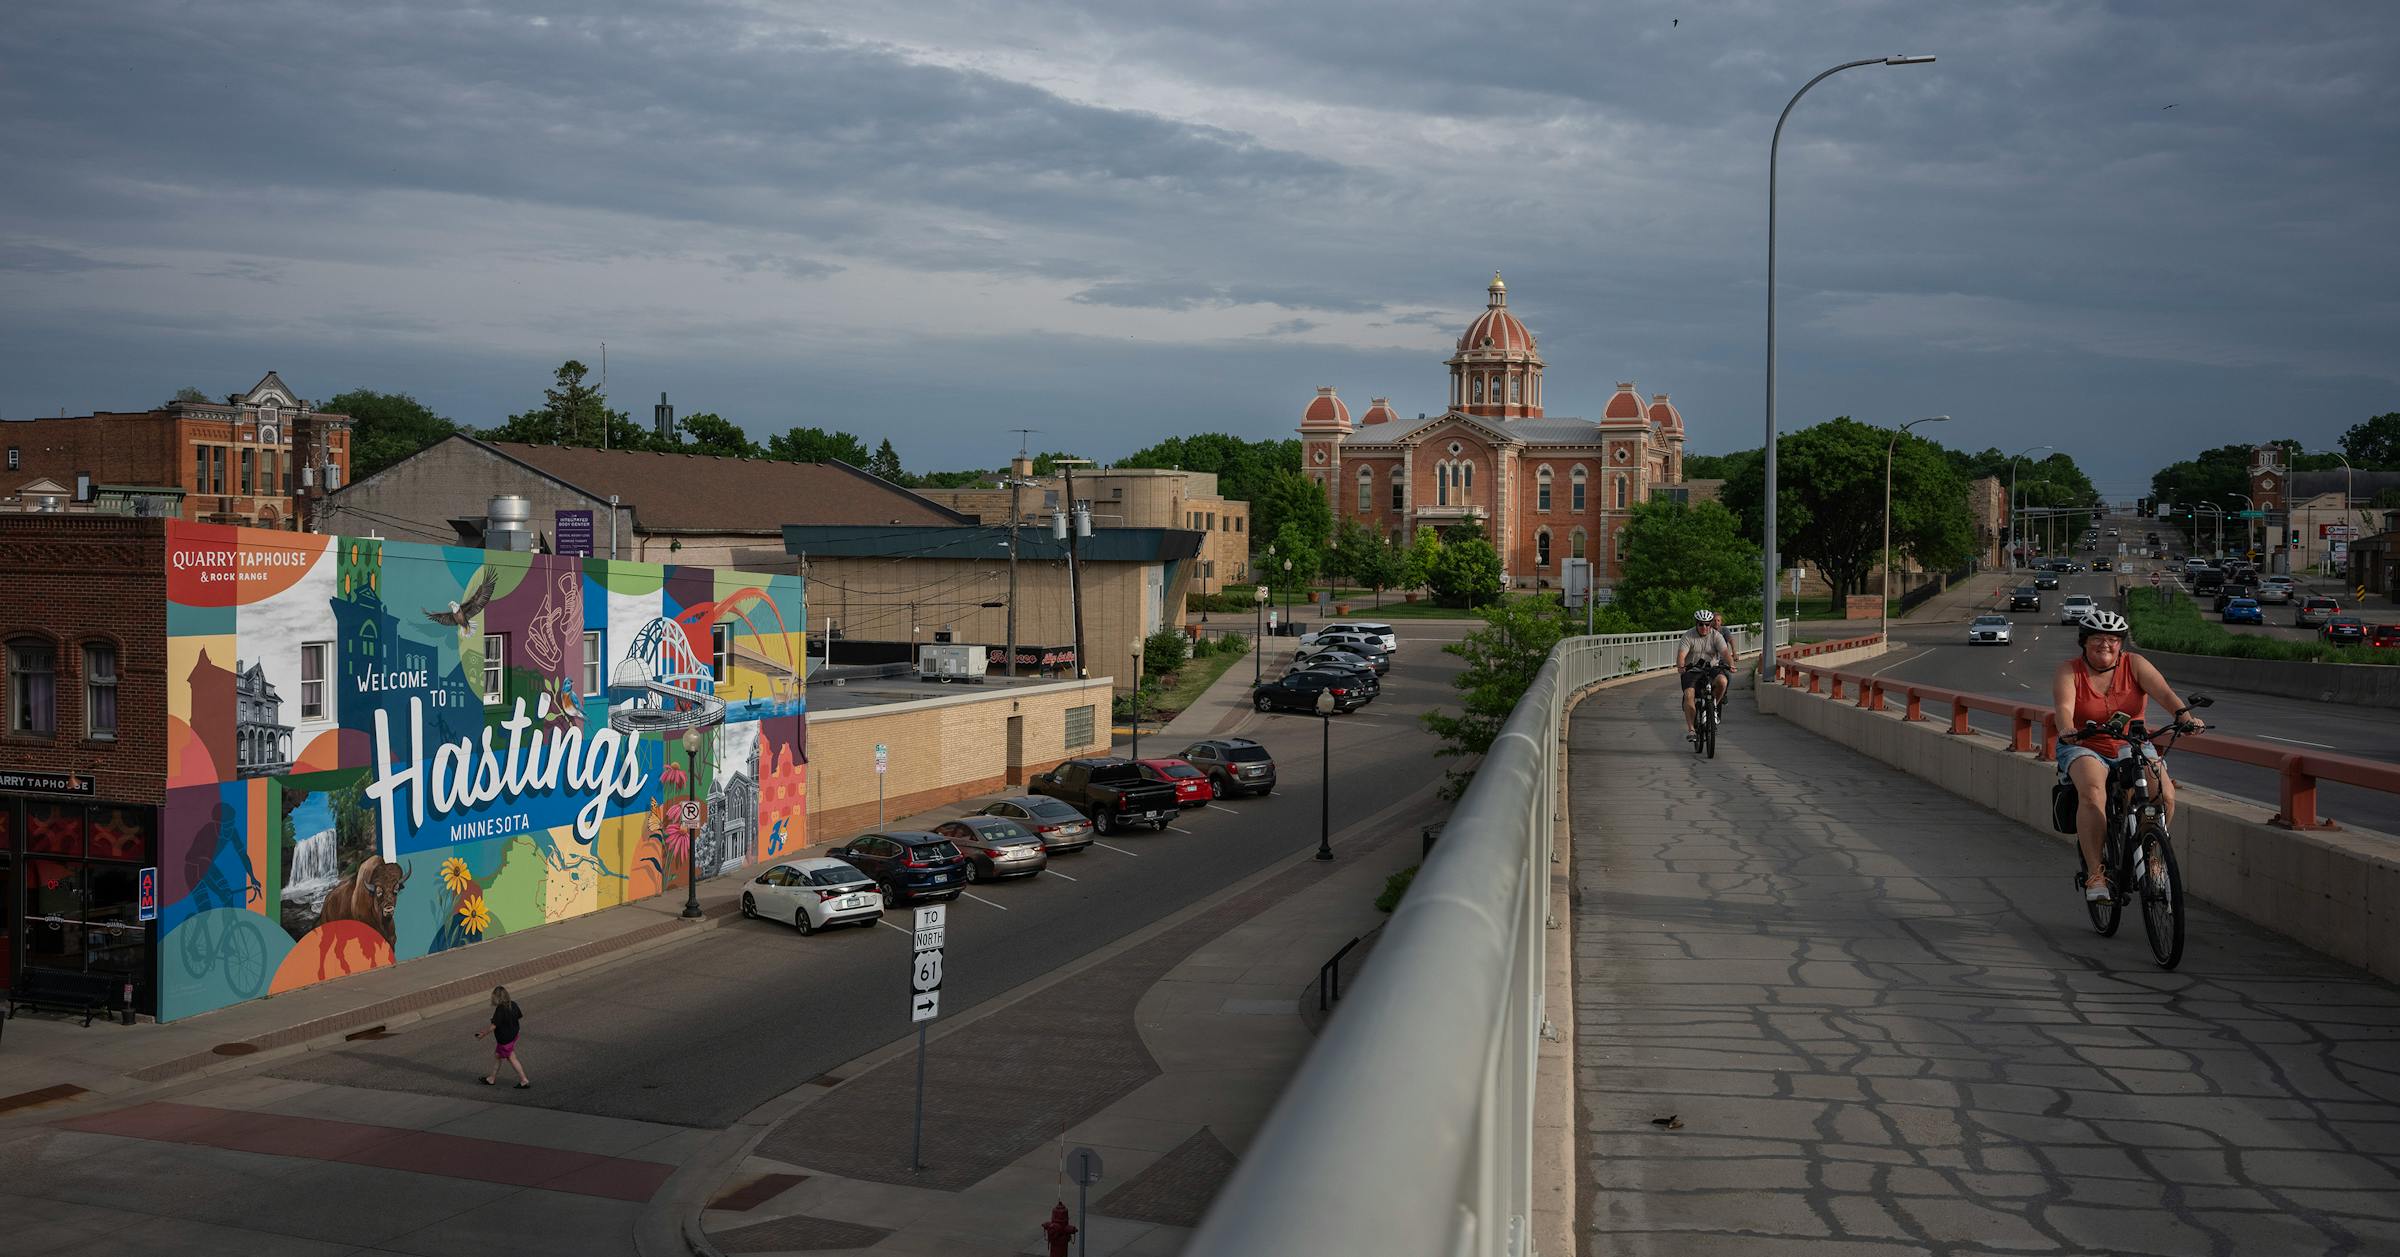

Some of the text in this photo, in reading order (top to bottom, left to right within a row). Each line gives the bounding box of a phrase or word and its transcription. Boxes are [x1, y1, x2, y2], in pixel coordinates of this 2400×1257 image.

[173, 551, 306, 570] QUARRY TAPHOUSE
[200, 571, 268, 582] & ROCK RANGE
[990, 650, 1037, 664] Tocco
[357, 663, 428, 692] WELCOME
[430, 689, 447, 707] TO
[28, 778, 89, 791] TAPHOE
[365, 692, 648, 864] Hastings
[450, 814, 530, 842] MINNESOTA
[142, 874, 153, 907] ATM
[924, 911, 938, 923] TO
[917, 931, 943, 947] NORTH
[920, 961, 936, 981] 61
